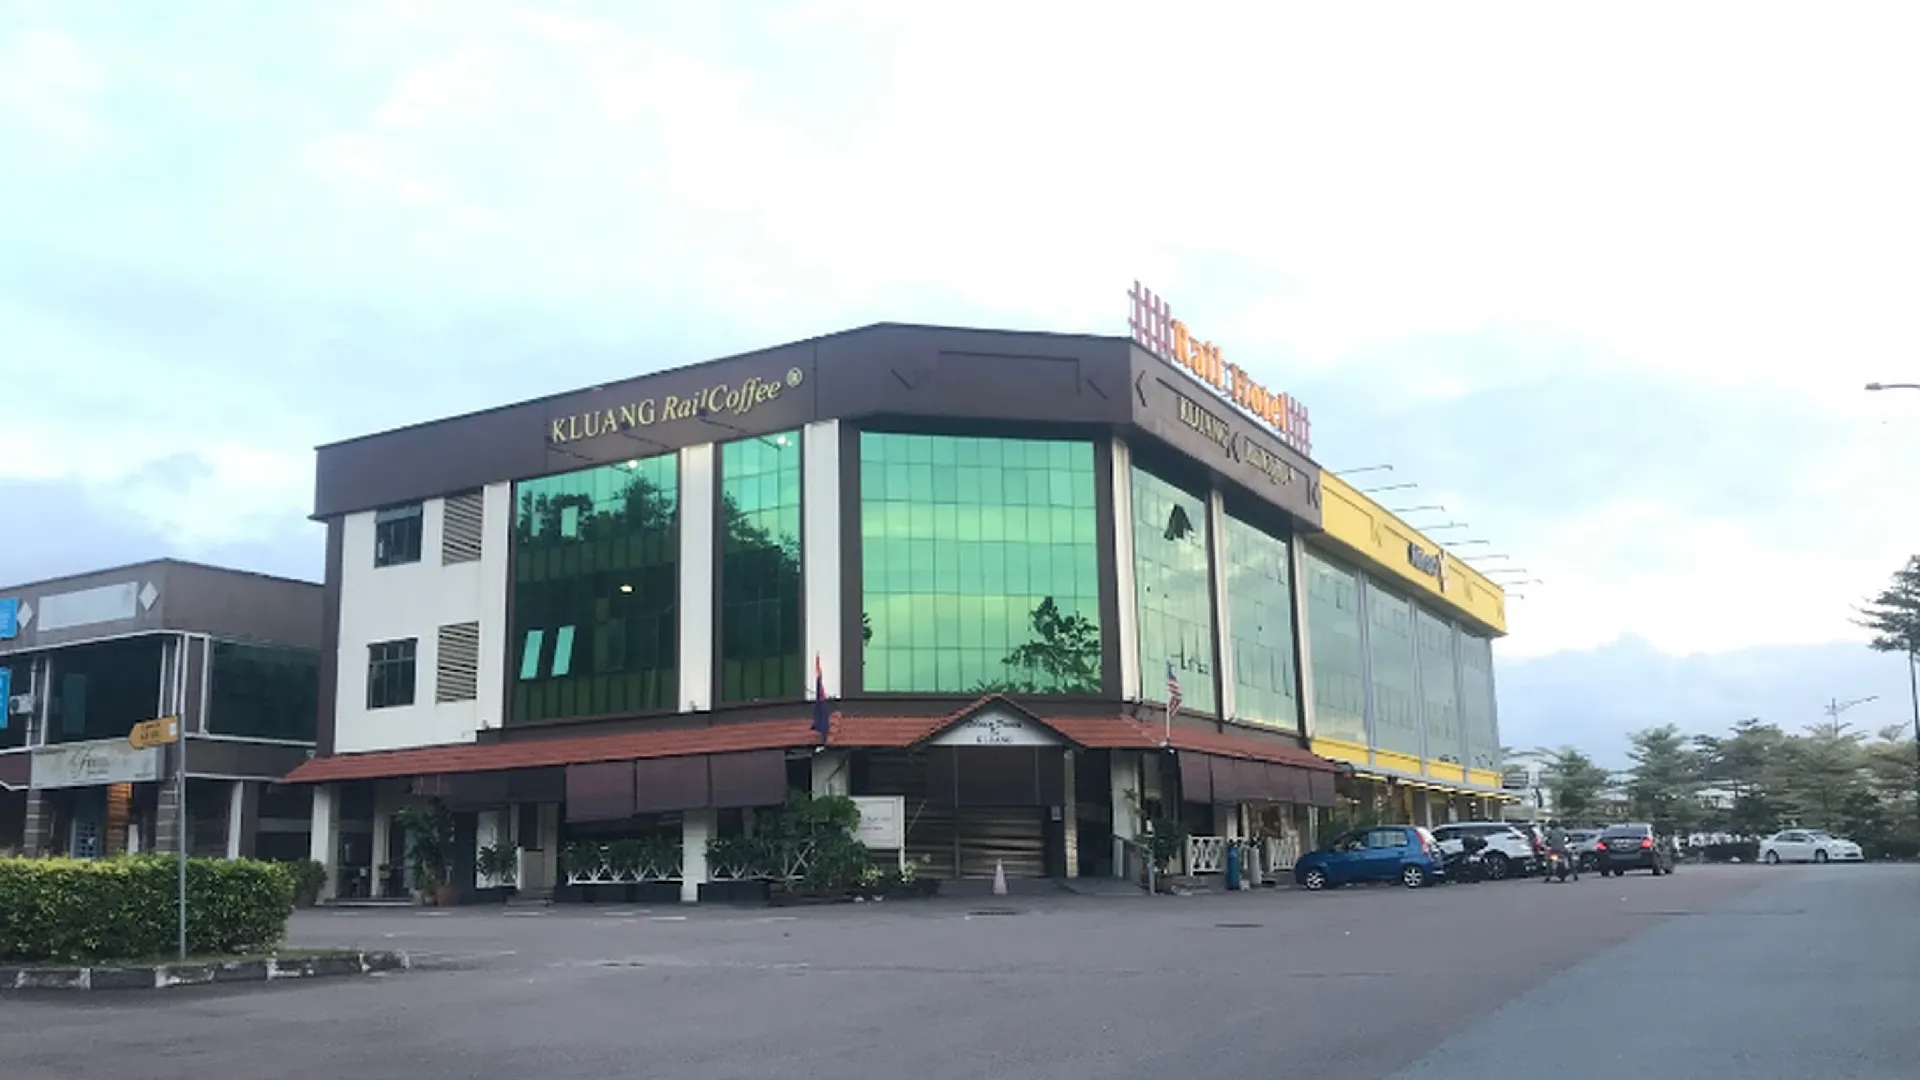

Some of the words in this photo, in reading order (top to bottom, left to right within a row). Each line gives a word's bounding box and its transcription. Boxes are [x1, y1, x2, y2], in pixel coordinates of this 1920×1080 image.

[1171, 319, 1225, 390] Rail
[1229, 362, 1289, 433] Hotel
[552, 398, 656, 444] KLUANG
